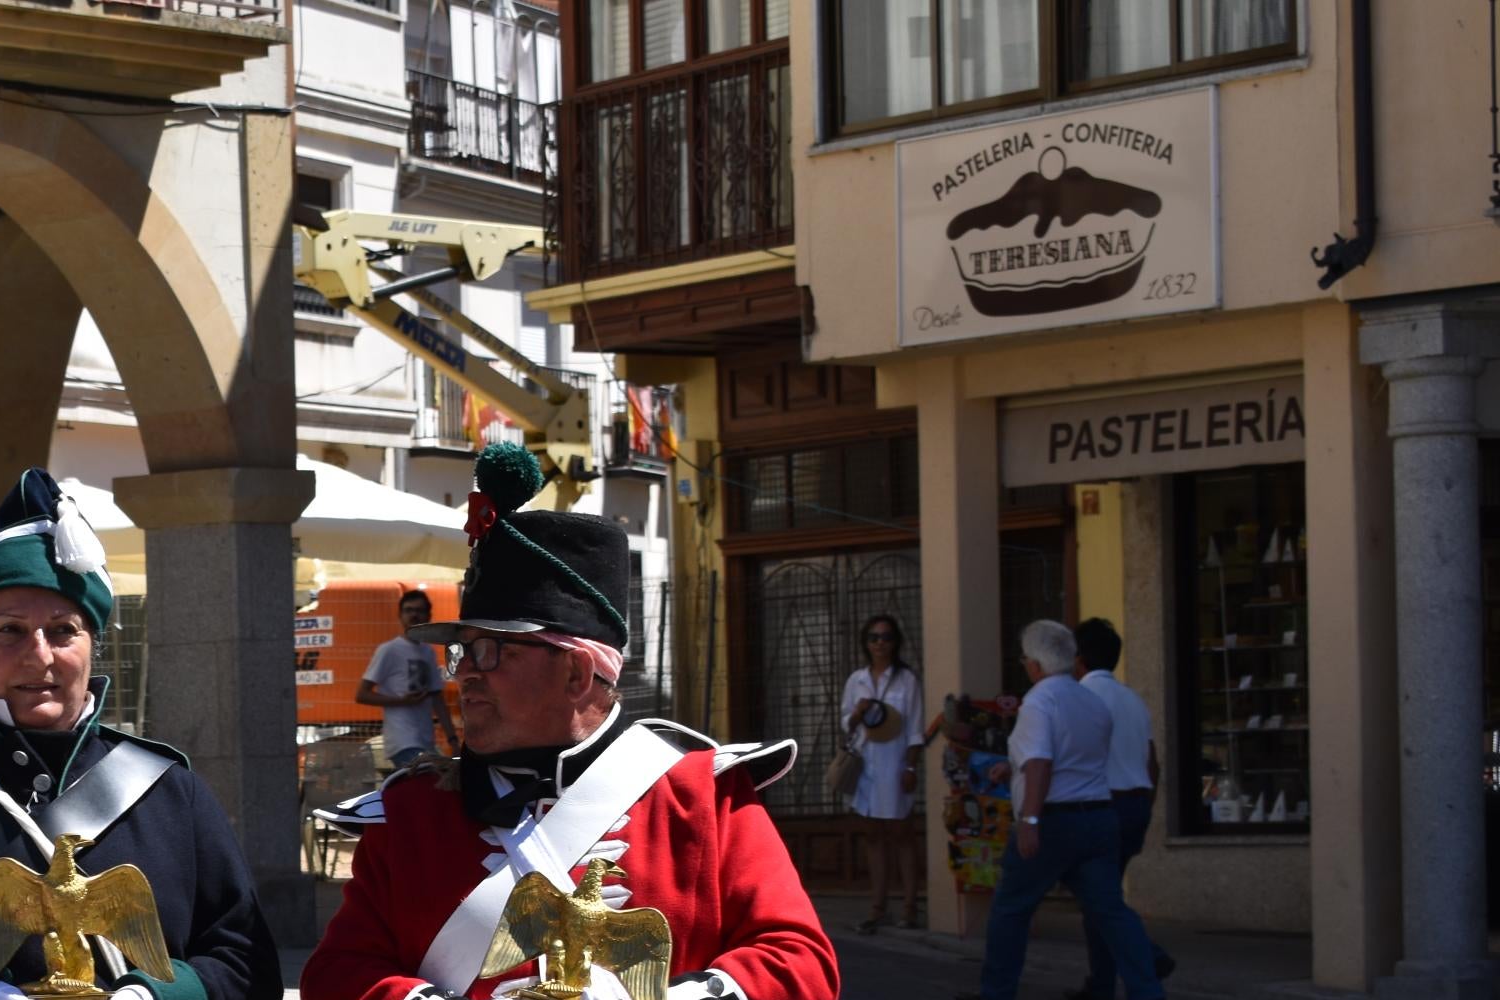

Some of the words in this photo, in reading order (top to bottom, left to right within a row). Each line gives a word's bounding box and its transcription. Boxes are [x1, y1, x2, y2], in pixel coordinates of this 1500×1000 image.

[932, 132, 1034, 201] PASTELERIA
[1062, 122, 1174, 165] CONFITERIA
[412, 222, 437, 234] LIFT
[969, 229, 1134, 275] TERESIANA
[1142, 272, 1197, 301] 1832
[913, 304, 963, 331] Desde
[1049, 388, 1305, 464] PASTELERÍA
